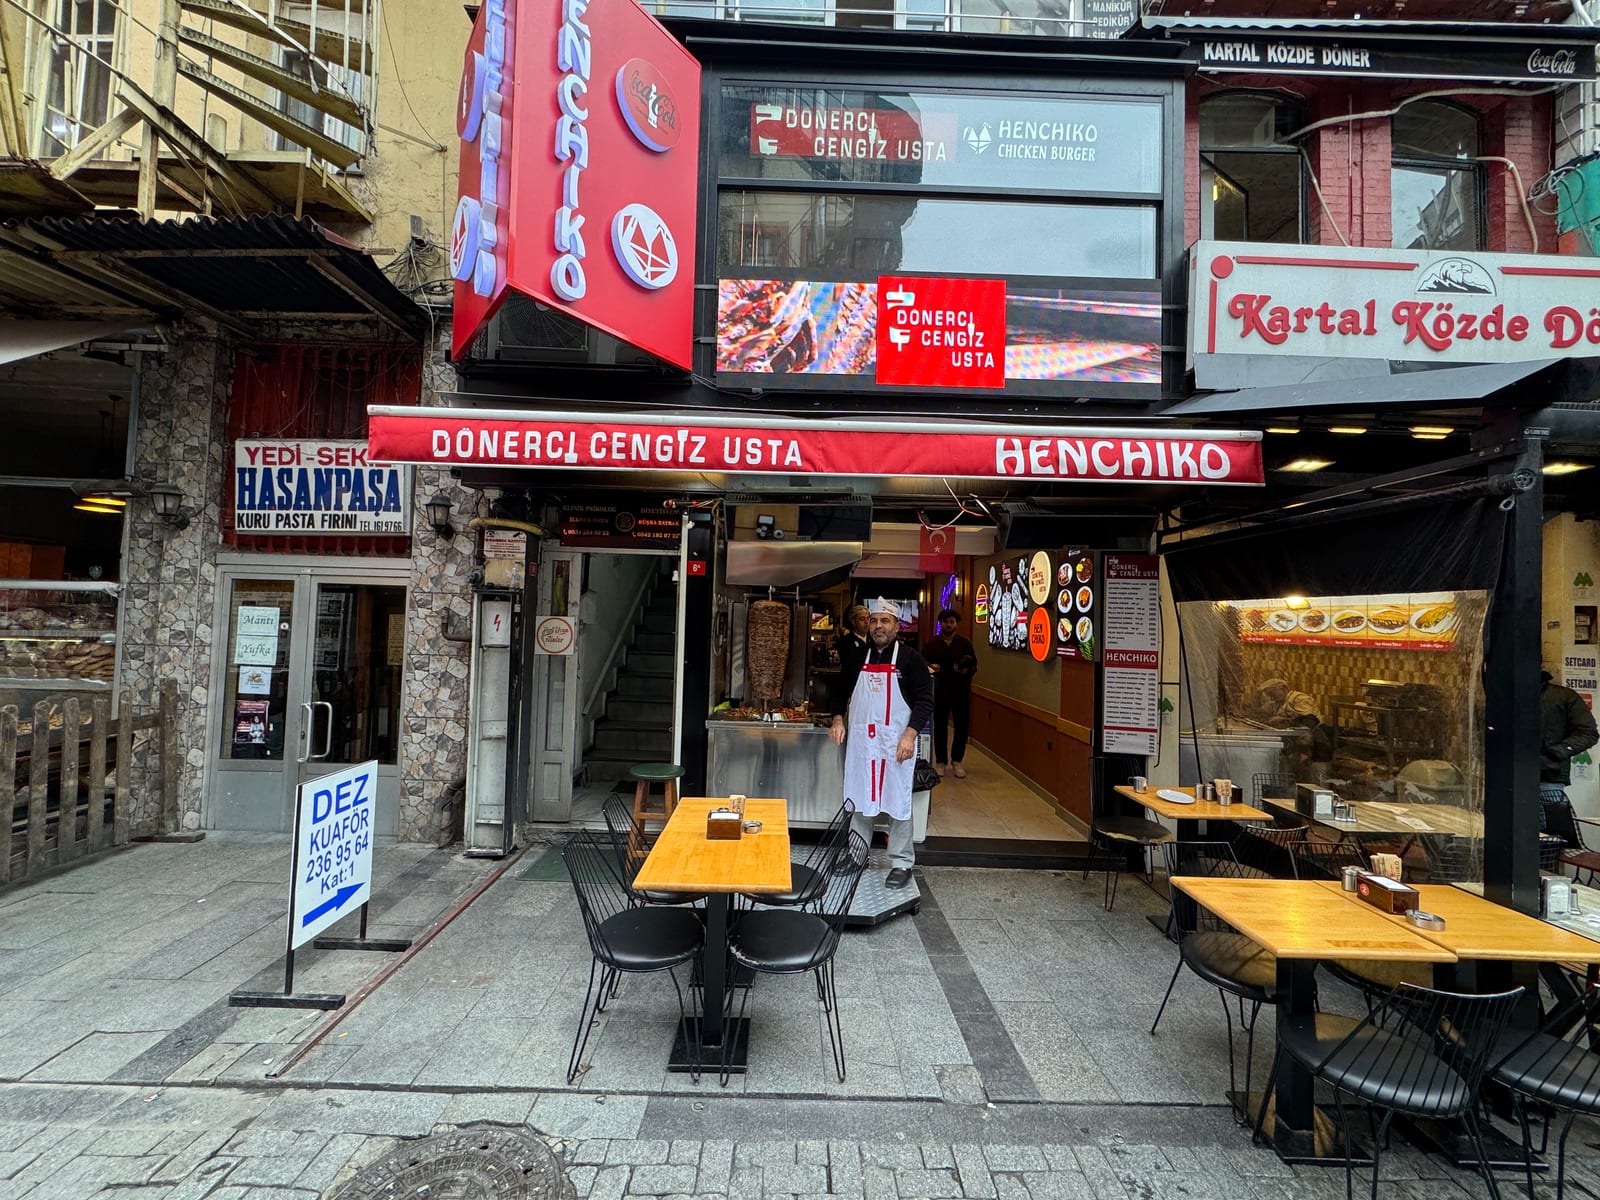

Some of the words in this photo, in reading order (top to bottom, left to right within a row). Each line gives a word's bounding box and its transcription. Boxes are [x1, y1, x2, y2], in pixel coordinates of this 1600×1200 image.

[1204, 43, 1260, 62] KARTAL
[1267, 41, 1315, 64] KÖZDE
[1322, 44, 1370, 67] DÖNER
[999, 120, 1098, 142] HENCHIKO
[897, 140, 946, 161] USTA
[998, 144, 1047, 159] CHICKEN
[1051, 146, 1096, 161] BURGER
[1229, 293, 1377, 344] Kartal
[1392, 300, 1530, 351] Közde
[951, 351, 995, 368] USTA
[723, 437, 803, 466] USTA
[995, 438, 1231, 479] HENCHIKO
[237, 467, 401, 517] HASANPAŞA
[237, 513, 270, 529] KURU
[275, 513, 315, 529] PASTA
[321, 514, 358, 529] FIRINI
[242, 643, 271, 656] Yufka
[1106, 652, 1157, 664] HENCHIKO
[1565, 657, 1596, 667] SETCARD
[1566, 679, 1597, 689] SETCARD
[311, 773, 369, 825] DEZ
[309, 808, 369, 855] KUAFÖR
[305, 850, 332, 883] 236
[336, 843, 351, 867] 95
[354, 831, 369, 855] 64
[320, 861, 354, 895] Kat:1
